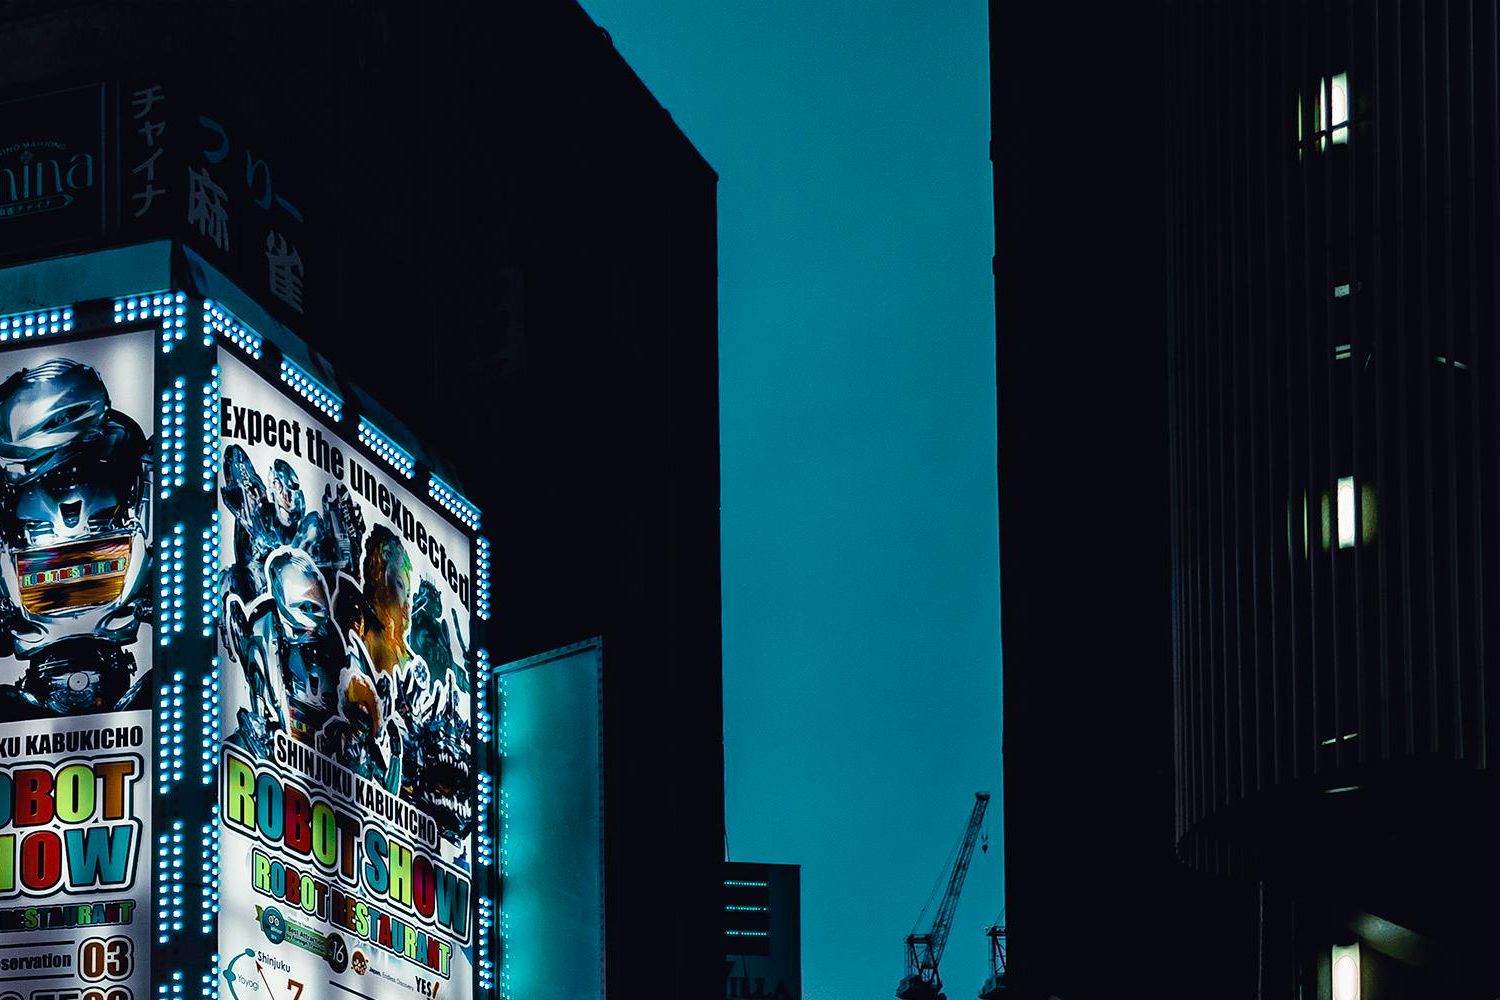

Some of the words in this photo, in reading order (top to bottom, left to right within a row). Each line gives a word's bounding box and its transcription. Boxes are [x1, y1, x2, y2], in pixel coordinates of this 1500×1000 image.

[131, 84, 167, 218] チャイナ
[220, 397, 302, 457] Expect
[305, 425, 345, 481] the
[349, 458, 470, 612] unexpected
[25, 725, 144, 756] KABUKICHO
[275, 734, 352, 799] SHINJUKU
[355, 774, 436, 848] KABUKICHO
[226, 757, 360, 881] ROBOT
[363, 824, 471, 940] SHOW
[0, 899, 135, 931] RESTAURANT
[80, 939, 133, 980] 03
[254, 851, 329, 918] ROBOT
[331, 886, 451, 978] RESTAURANT
[257, 951, 291, 974] Shinjuku
